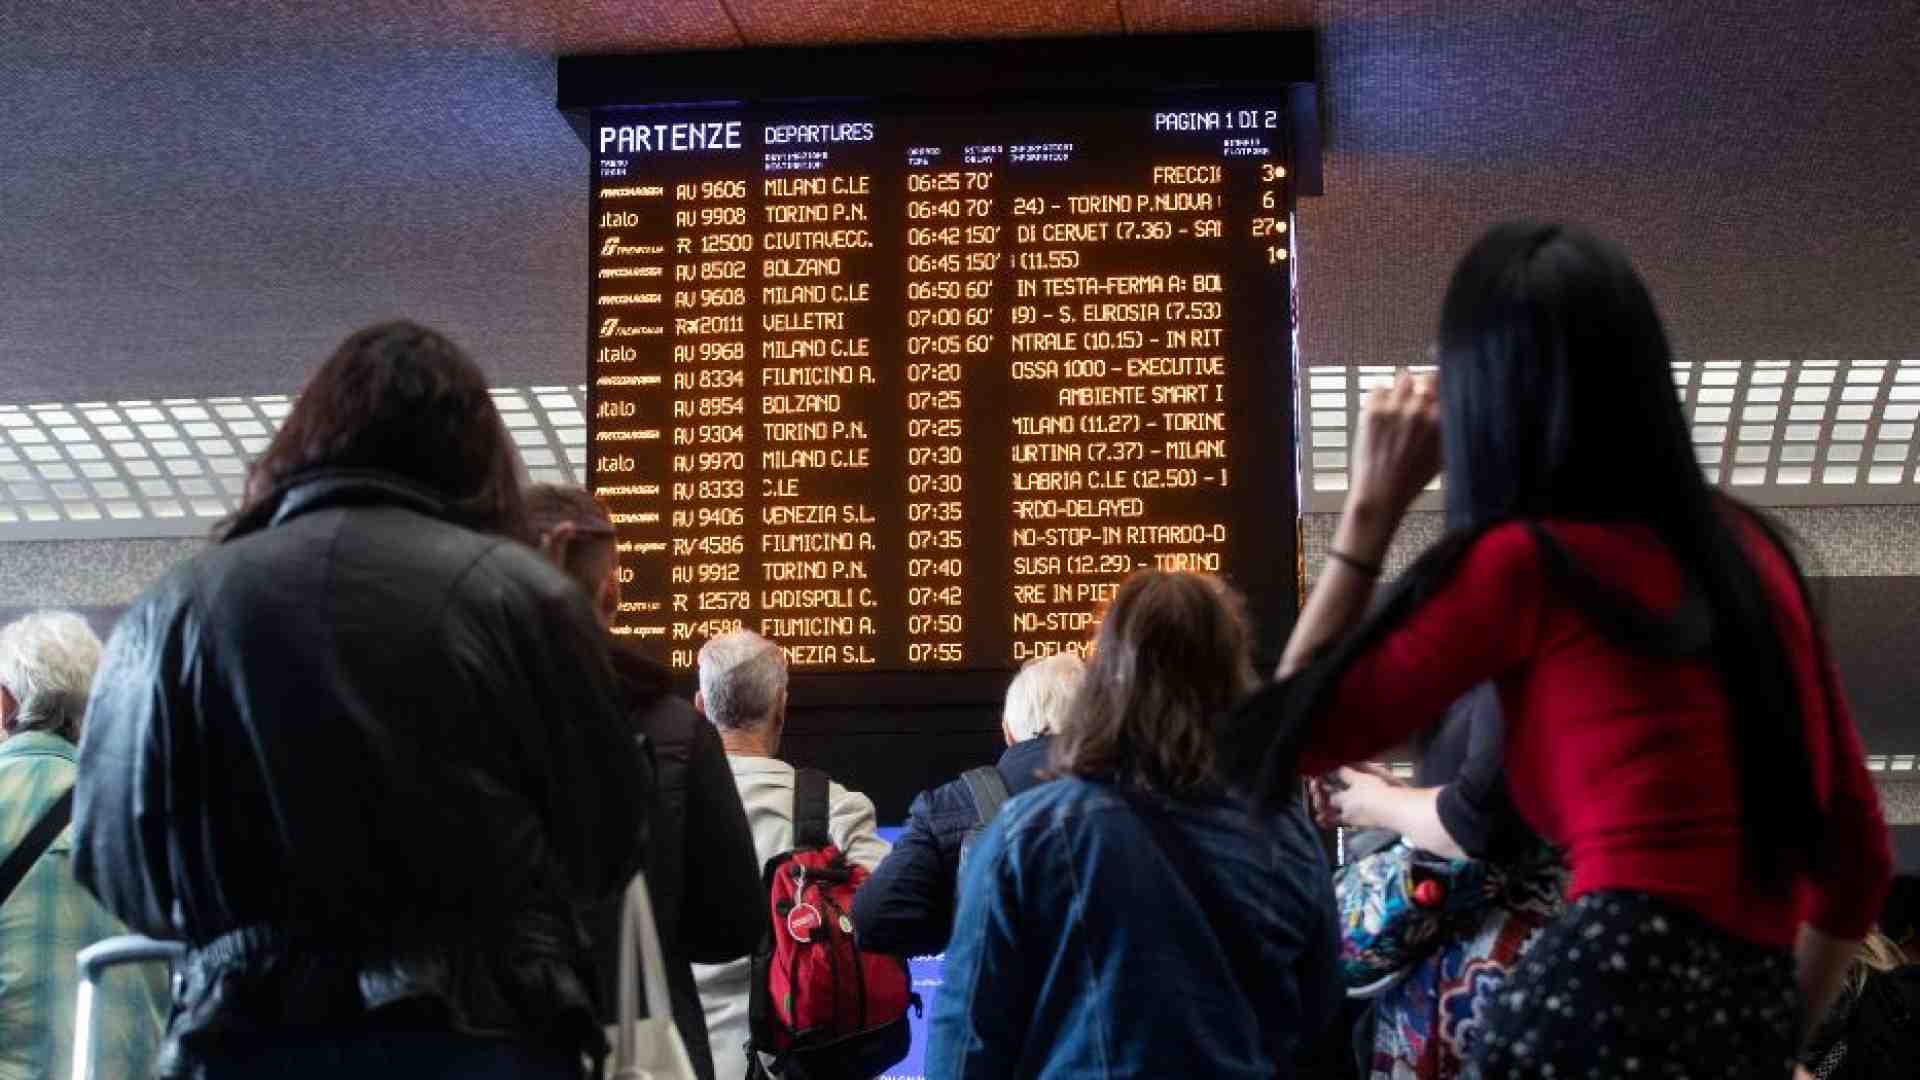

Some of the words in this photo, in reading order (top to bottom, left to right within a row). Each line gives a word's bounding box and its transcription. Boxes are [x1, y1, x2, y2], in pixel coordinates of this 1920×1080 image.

[765, 123, 873, 144] DEPARTURES
[1156, 113, 1219, 130] PAGINA
[1226, 113, 1233, 128] 1
[1239, 111, 1258, 128] DI
[1265, 111, 1276, 128] 2
[601, 122, 741, 152] PARTENZE
[677, 184, 697, 200] AV
[702, 181, 745, 198] 9606
[765, 177, 826, 196] MILANO
[832, 176, 869, 194] C.LE
[908, 173, 959, 192] 06:25
[965, 172, 992, 189] 70'
[1263, 164, 1276, 181] 3
[677, 210, 696, 227] AV
[701, 207, 745, 226] 9908
[765, 204, 828, 223] TORINO
[833, 203, 867, 220] P.N.
[908, 199, 960, 218] 06:40
[965, 199, 992, 216] 70'
[1068, 195, 1132, 214] TORINO
[1138, 193, 1212, 212] P.NUOVA
[1263, 191, 1274, 208] 6
[677, 238, 692, 253] R
[701, 234, 753, 253] 12500
[763, 230, 873, 250] CIVITAVECC.
[908, 227, 960, 245] 06:42
[965, 226, 1000, 244] 150'
[1018, 224, 1036, 243] DI
[1043, 222, 1108, 241] CERVET
[1117, 222, 1171, 239] (7.36)
[1253, 218, 1277, 236] 27
[675, 265, 696, 282] AV
[701, 261, 745, 280] 8502
[763, 257, 840, 278] BOLZANO
[907, 255, 960, 272] 06:45
[965, 253, 1000, 271] 150'
[1020, 251, 1079, 270] (11.55)
[1268, 247, 1278, 263] 1
[675, 292, 696, 308] AV
[699, 288, 745, 307] 9608
[763, 286, 826, 305] MILANO
[831, 284, 869, 303] C.LE
[908, 281, 961, 300] 06:50
[965, 280, 992, 299] 60'
[1017, 280, 1036, 296] IN
[1042, 275, 1163, 296] TESTA-FERMA
[1169, 275, 1186, 292] A:
[763, 312, 844, 332] VELLETRI
[908, 308, 961, 327] 07:00
[965, 308, 993, 325] 60'
[1059, 306, 1076, 323] S.
[1084, 304, 1159, 321] EUROSIA
[1166, 302, 1221, 319] (7.53)
[675, 345, 696, 363] AV
[699, 342, 745, 360] 9968
[763, 339, 826, 359] MILANO
[830, 338, 869, 356] C.LE
[908, 335, 961, 354] 07:05
[965, 335, 994, 352] 60'
[1012, 333, 1077, 352] NTRALE
[1084, 331, 1143, 350] (10.15)
[1166, 330, 1186, 348] IN
[1191, 329, 1222, 347] RIT
[675, 372, 694, 390] AV
[699, 370, 744, 388] 8334
[763, 366, 852, 386] FIUMICINO
[859, 366, 875, 383] A.
[907, 363, 961, 382] 07:20
[1012, 360, 1058, 379] OSSA
[1064, 360, 1105, 378] 1000
[1127, 356, 1224, 377] EXECUTIVE
[675, 400, 694, 418] AV
[699, 397, 743, 416] 8954
[762, 395, 840, 414] BOLZANO
[907, 391, 961, 410] 07:25
[1059, 386, 1146, 406] AMBIENTE
[1152, 384, 1208, 404] SMART
[674, 427, 696, 445] AV
[699, 424, 744, 443] 9304
[763, 421, 828, 441] TORINO
[833, 421, 867, 439] P.N.
[909, 419, 961, 437] 07:25
[1080, 414, 1140, 432] (11.27)
[673, 454, 694, 472] AV
[699, 452, 744, 472] 9970
[763, 450, 826, 469] MILANO
[831, 448, 869, 467] C.LE
[909, 446, 961, 465] 07:30
[1088, 442, 1144, 461] (7.37)
[673, 483, 694, 500] AV
[699, 479, 743, 499] 8333
[909, 474, 962, 493] 07:30
[1088, 471, 1127, 489] C.LE
[1133, 469, 1197, 488] (12.50)
[673, 510, 694, 527] AV
[699, 507, 743, 527] 9406
[763, 506, 837, 525] VENEZIA
[843, 505, 875, 523] S.L.
[909, 502, 961, 521] 07:35
[698, 535, 744, 554] 4586
[762, 532, 853, 552] FIUMICINO
[859, 532, 875, 550] A.
[909, 530, 962, 550] 07:35
[1012, 526, 1122, 546] NO-STOP-IN
[672, 565, 693, 584] AV
[697, 563, 740, 582] 9912
[762, 561, 828, 581] TORINO
[833, 561, 867, 579] P.N.
[909, 559, 961, 576] 07:40
[1014, 557, 1060, 575] SUSA
[1068, 555, 1132, 577] (12.29)
[1154, 553, 1219, 575] TORINO
[673, 594, 688, 611] R
[698, 591, 750, 609] 12578
[761, 588, 852, 609] LADISPOLI
[859, 588, 877, 607] C.
[909, 586, 961, 605] 07:42
[1053, 584, 1072, 603] IN
[760, 617, 854, 639] FIUMICINO
[859, 617, 875, 634] A.
[909, 615, 961, 634] 07:50
[672, 650, 692, 667] AV
[843, 646, 875, 663] S.L.
[909, 643, 962, 661] 07:55
